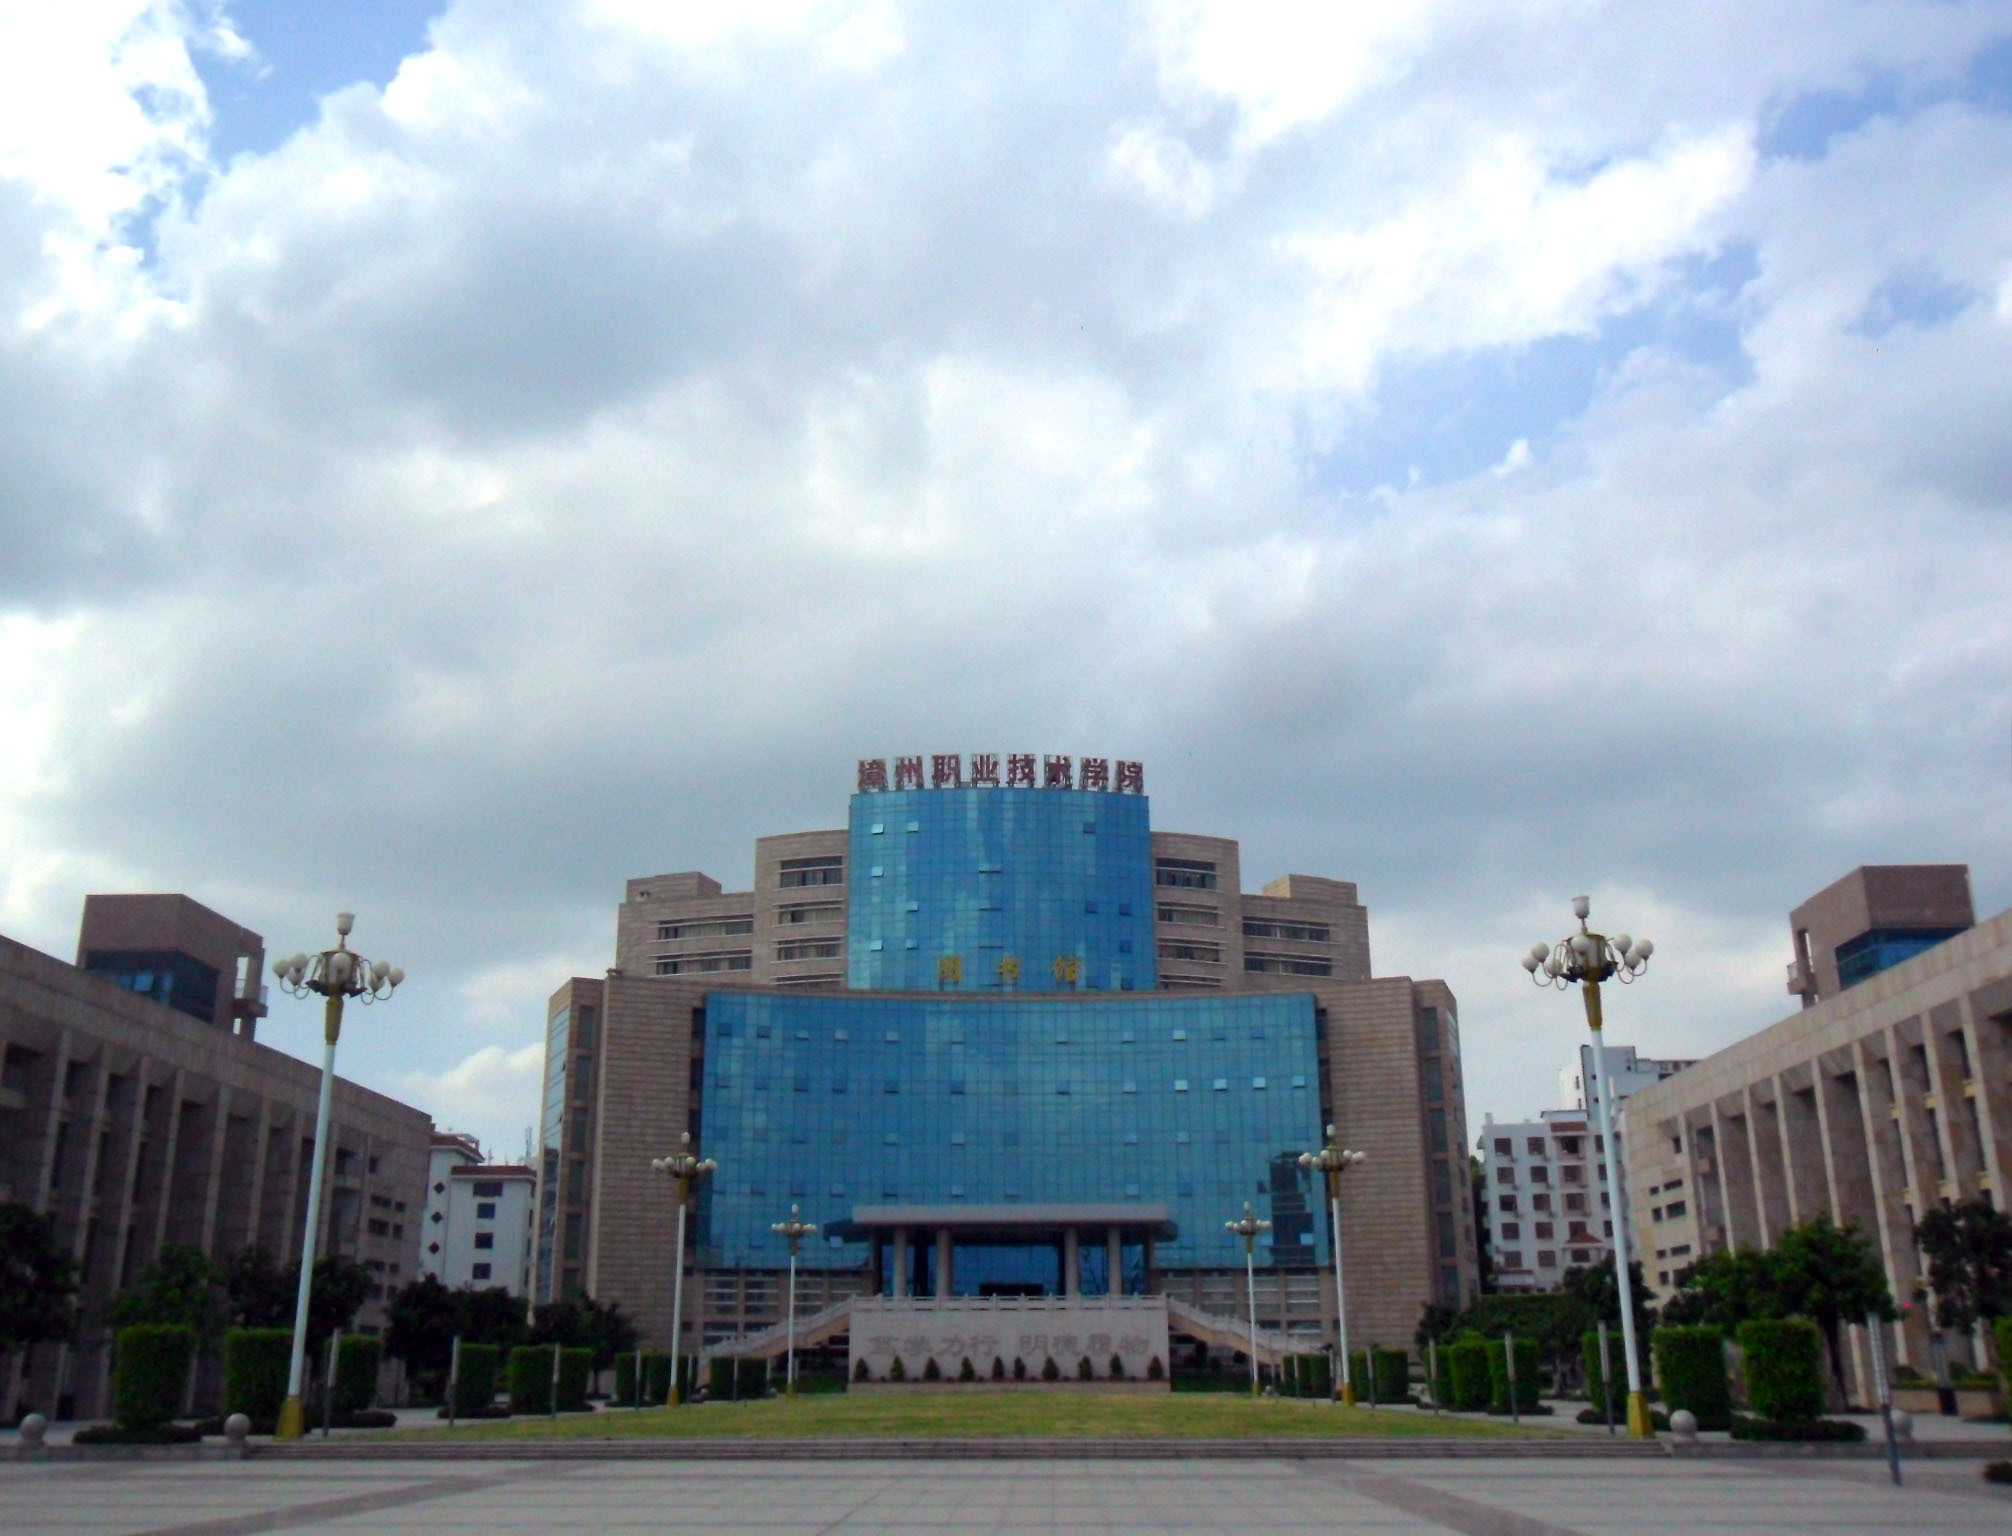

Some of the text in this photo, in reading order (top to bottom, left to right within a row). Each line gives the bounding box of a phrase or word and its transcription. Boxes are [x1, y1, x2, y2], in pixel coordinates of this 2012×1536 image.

[857, 753, 1144, 791] 漳州职业技术学院
